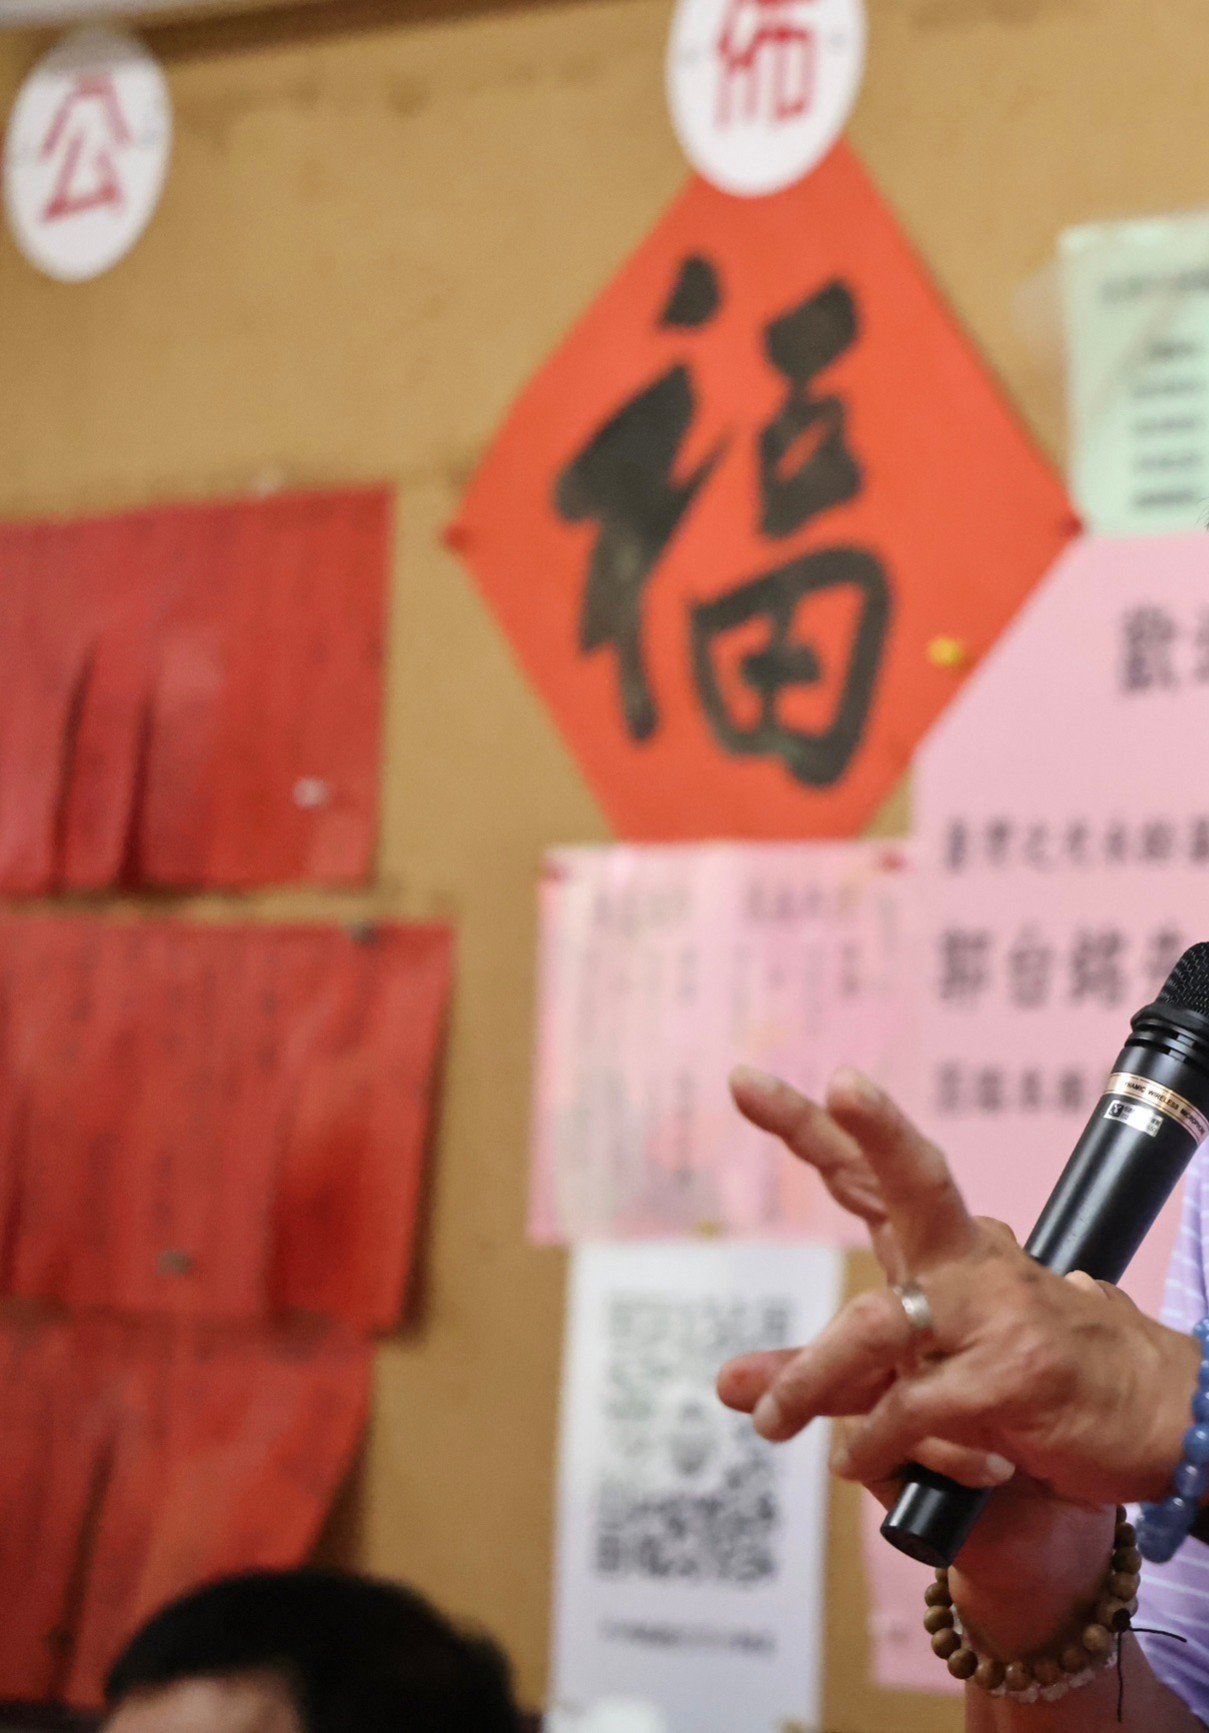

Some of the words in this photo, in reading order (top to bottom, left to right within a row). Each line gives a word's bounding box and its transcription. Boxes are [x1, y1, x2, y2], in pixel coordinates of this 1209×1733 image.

[40, 71, 132, 224] 公
[553, 250, 892, 790] 福
[1147, 1089, 1179, 1110] WIRELESS
